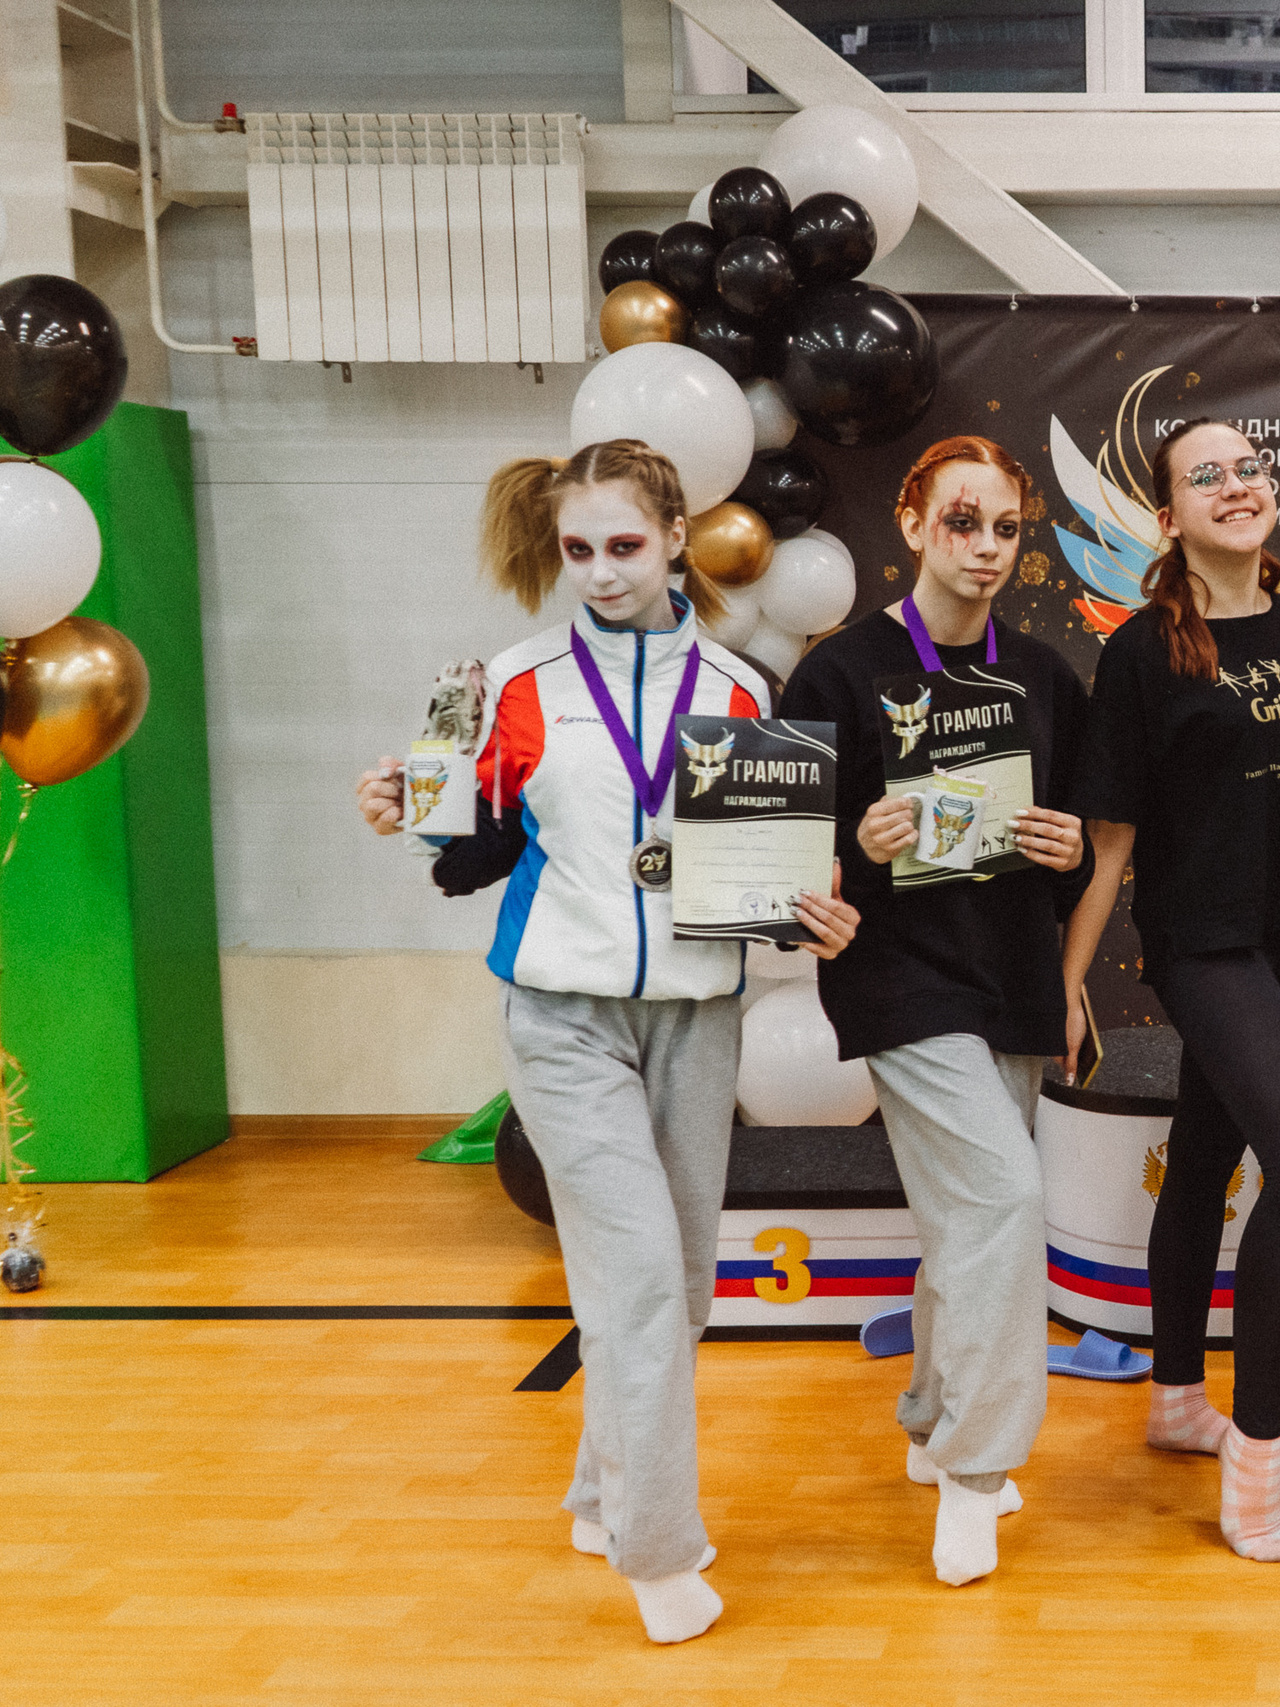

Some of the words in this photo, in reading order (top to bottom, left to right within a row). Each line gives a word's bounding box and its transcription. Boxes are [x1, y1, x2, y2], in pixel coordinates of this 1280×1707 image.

[932, 702, 1014, 735] ГРАМОТА
[929, 741, 986, 760] НАГРАЖДАЕТСЯ
[733, 759, 821, 785] ГРАМОТА
[723, 795, 787, 808] НАГРАЖДАЕТСЯ
[753, 1227, 812, 1304] 3
